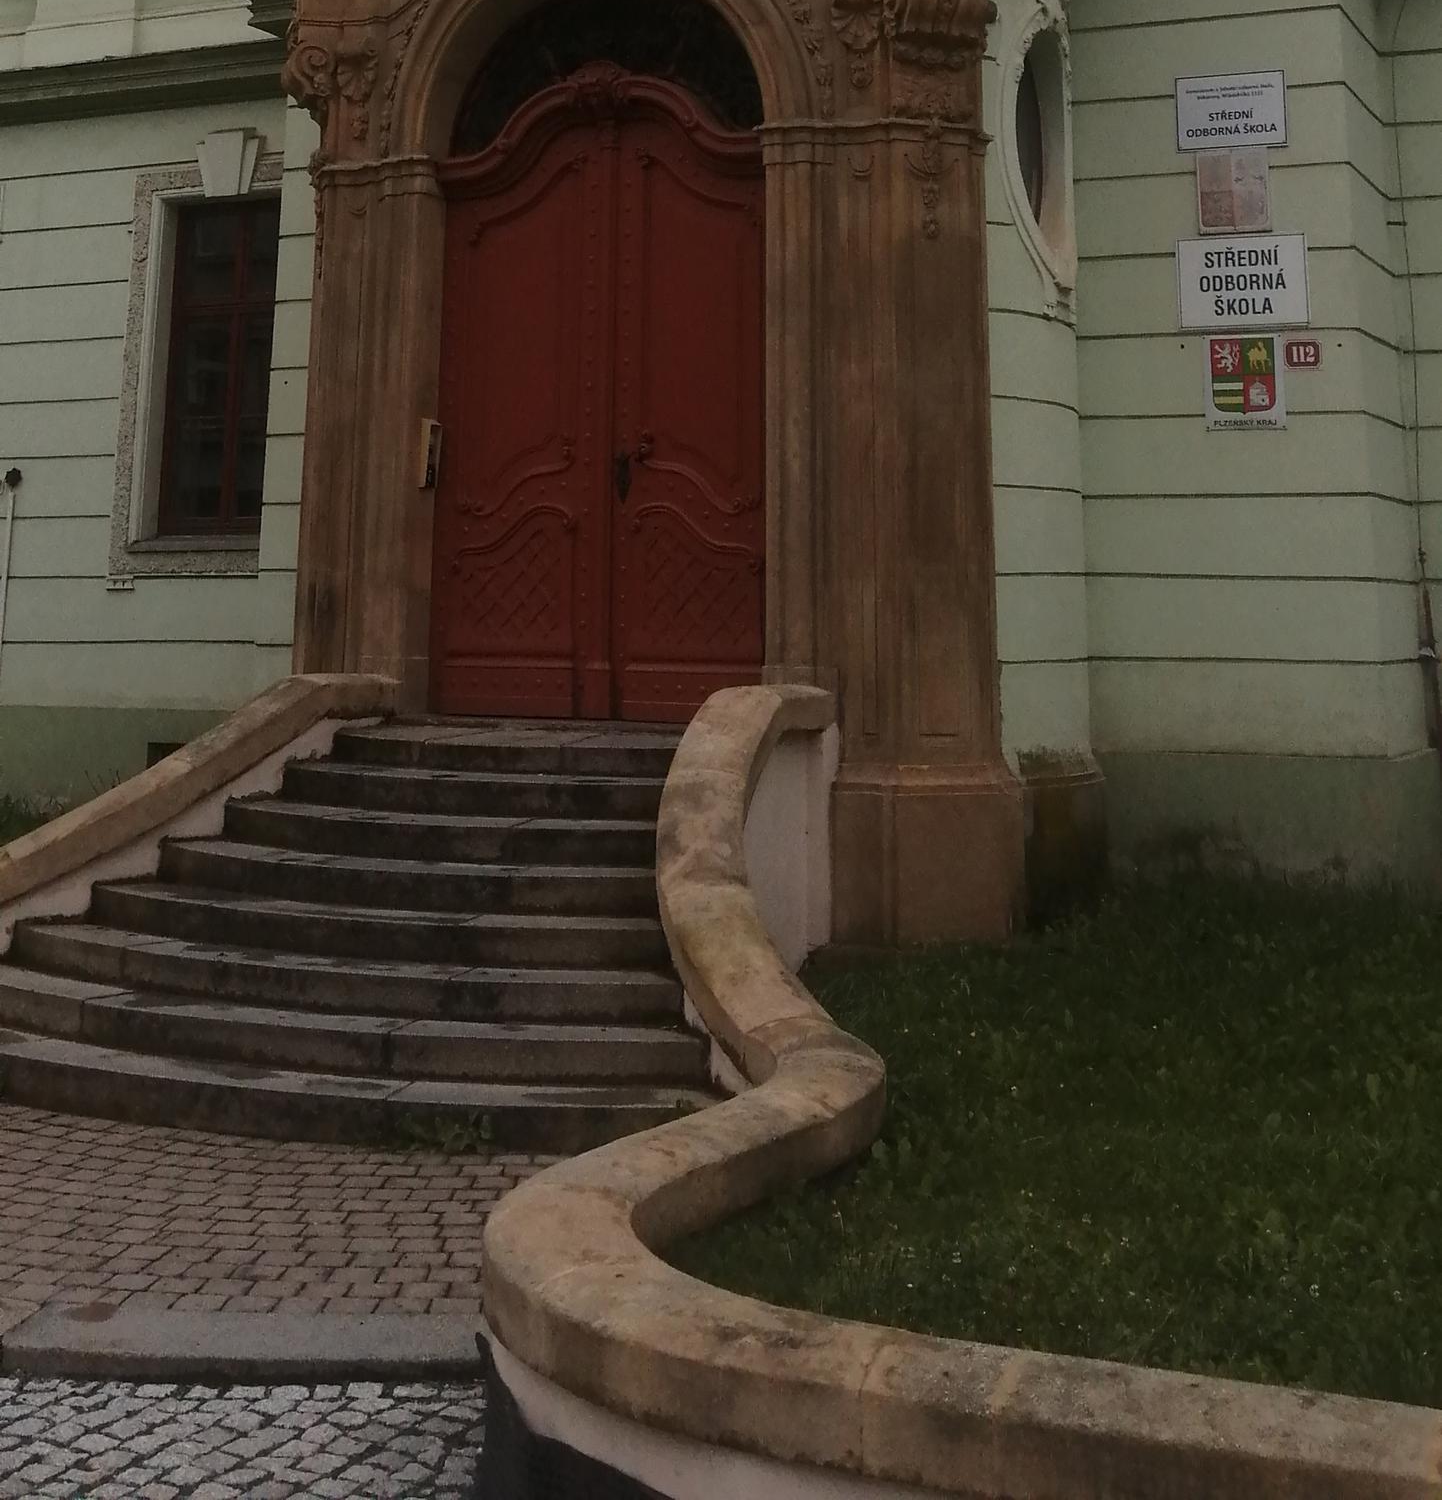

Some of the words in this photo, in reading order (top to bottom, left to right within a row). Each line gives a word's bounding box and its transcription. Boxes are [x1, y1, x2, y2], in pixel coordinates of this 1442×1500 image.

[1208, 107, 1254, 122] STŘEDNÍ
[1186, 123, 1240, 138] ODBORNÁ
[1243, 122, 1278, 134] ŠKOLA
[1204, 244, 1279, 269] STŘEDNÍ
[1200, 268, 1287, 292] ODBORNÁ
[1214, 295, 1274, 316] ŠKOLA
[1291, 345, 1316, 363] 112
